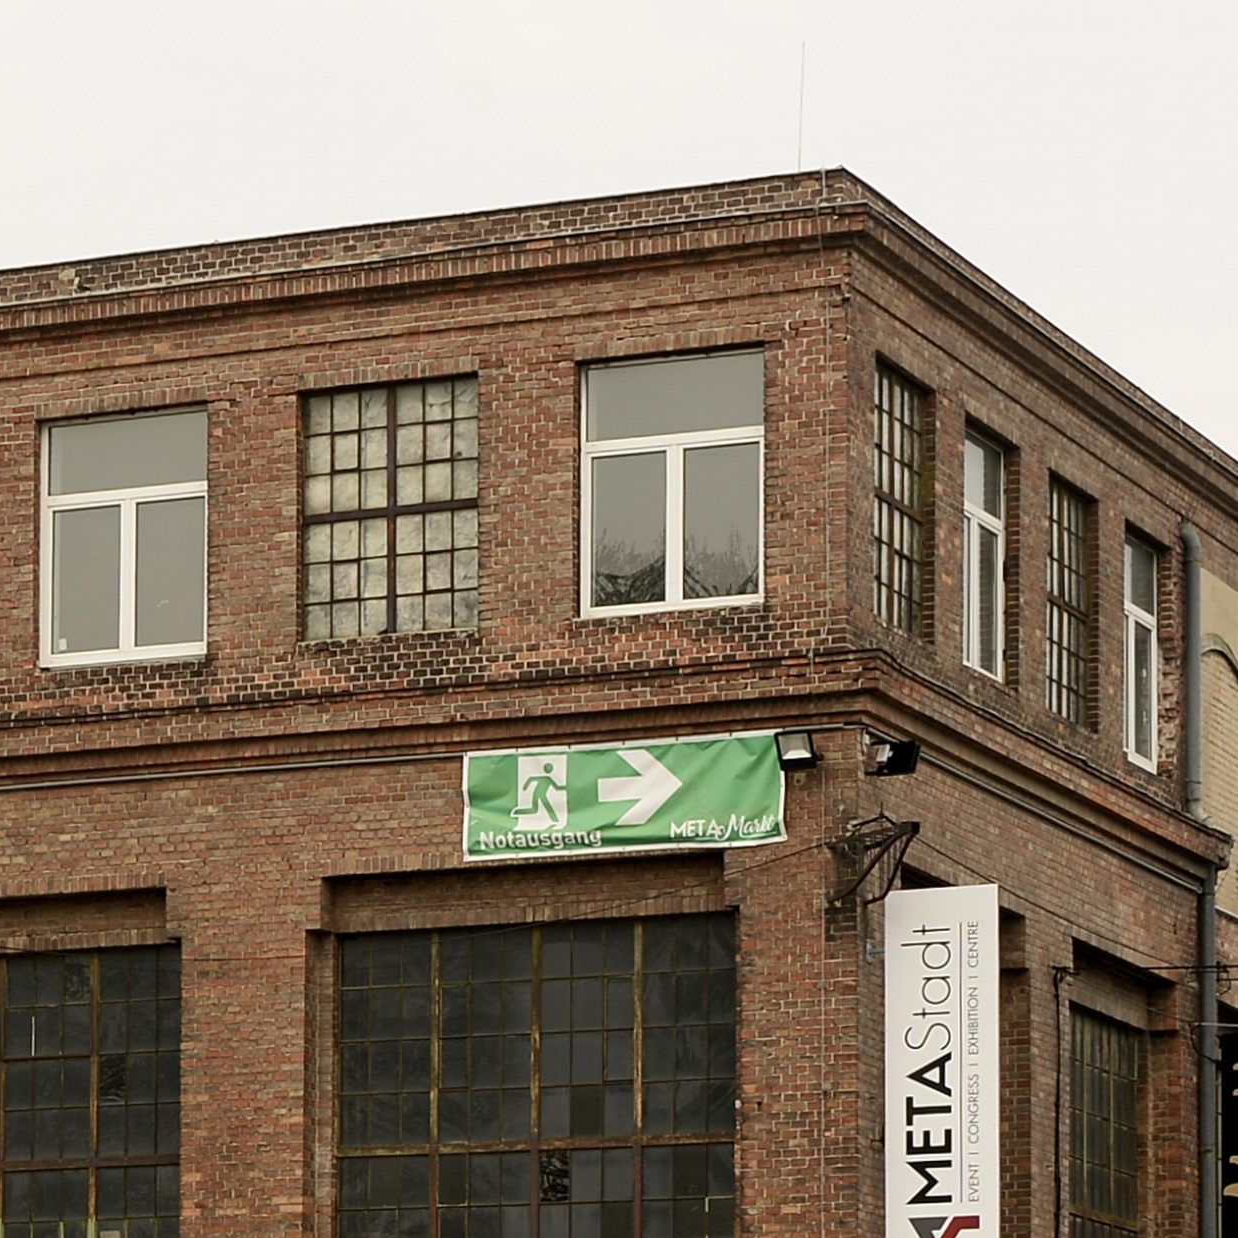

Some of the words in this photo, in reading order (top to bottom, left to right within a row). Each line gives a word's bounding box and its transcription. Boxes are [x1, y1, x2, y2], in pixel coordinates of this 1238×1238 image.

[479, 829, 602, 850] Notausgang
[967, 920, 979, 969] CENTRE
[967, 986, 980, 1056] EXHIBITION
[900, 924, 953, 1205] METAStadt
[968, 1073, 980, 1145] CONGRESS
[968, 1162, 980, 1203] EVENT
